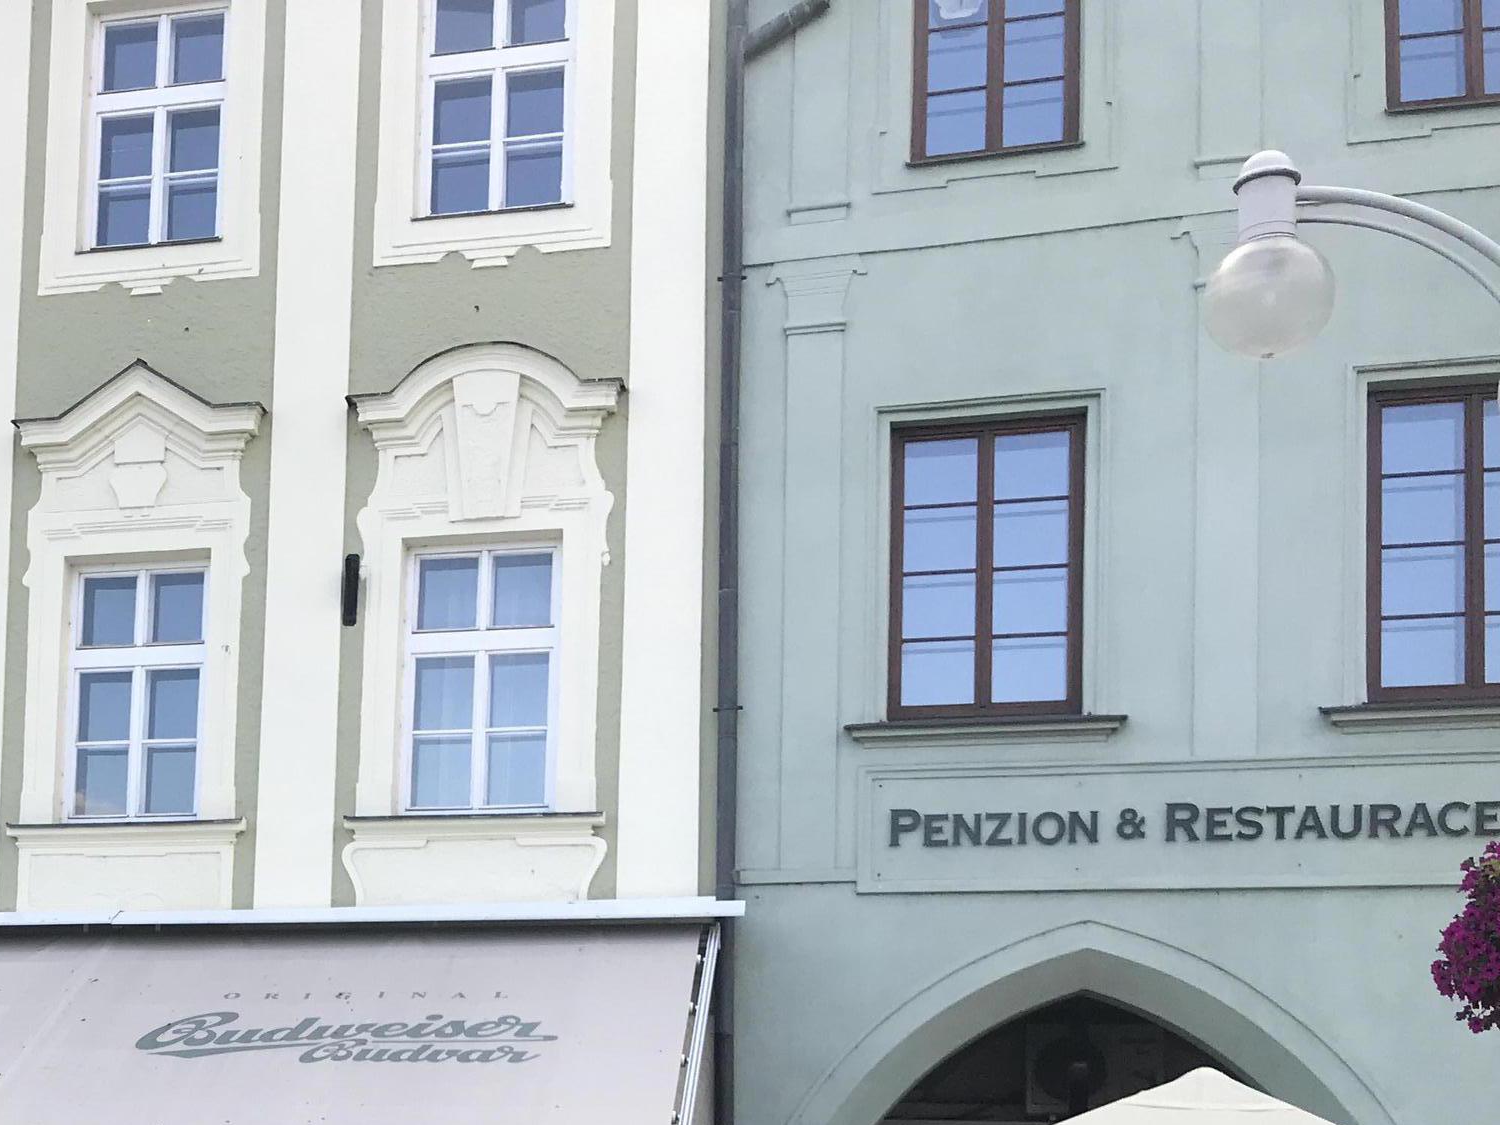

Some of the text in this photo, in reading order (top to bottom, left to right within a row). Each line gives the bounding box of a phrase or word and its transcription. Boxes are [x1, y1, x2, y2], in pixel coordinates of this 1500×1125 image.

[888, 800, 1500, 848] PENZION & RESTAURACE
[223, 991, 510, 1001] ORIGINAL
[135, 1011, 559, 1056] Budweiser
[298, 1040, 542, 1065] Budvar
